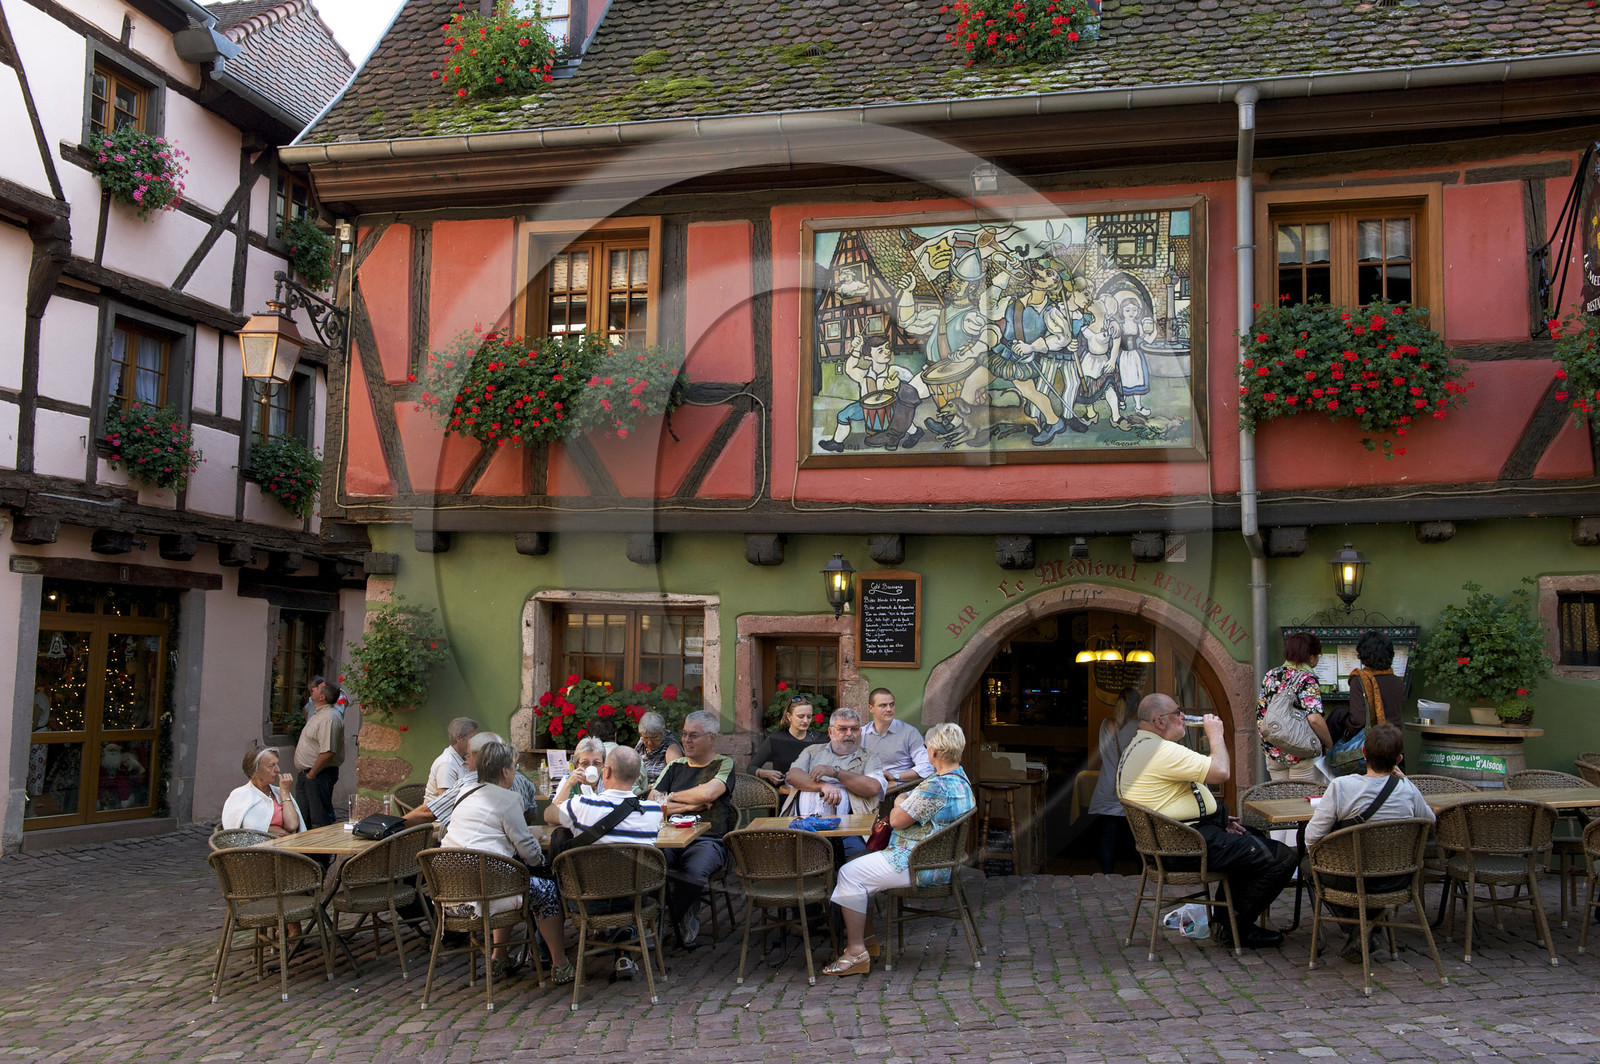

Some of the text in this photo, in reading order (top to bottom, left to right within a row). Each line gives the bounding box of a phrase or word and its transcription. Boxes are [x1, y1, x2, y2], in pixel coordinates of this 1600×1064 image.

[945, 558, 1250, 646] BAR Le Médiéval RESTAURANT
[1446, 754, 1481, 763] nouvelle
[1475, 759, 1504, 772] d'Alsace
